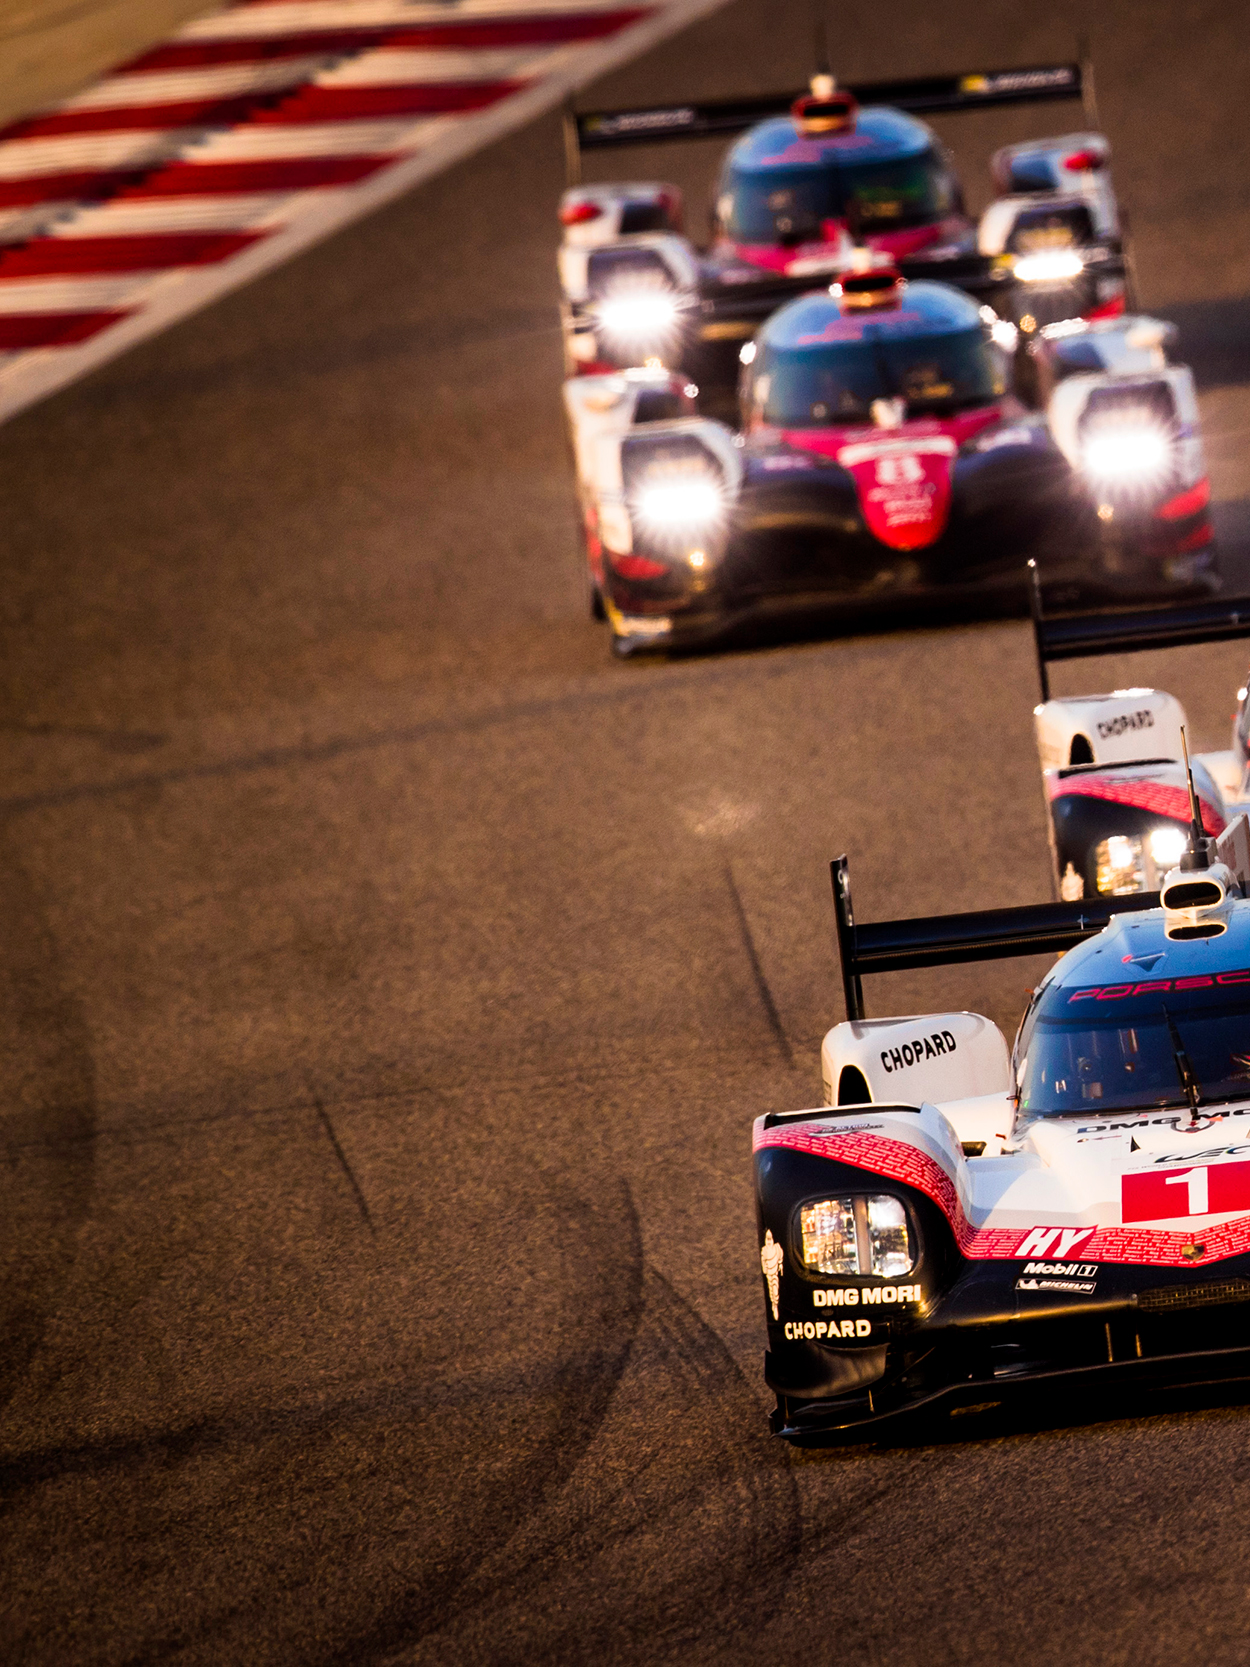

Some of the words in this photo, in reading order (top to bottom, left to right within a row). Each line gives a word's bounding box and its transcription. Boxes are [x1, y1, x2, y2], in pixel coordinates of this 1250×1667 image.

[1096, 709, 1155, 740] CHOPARD
[880, 1030, 957, 1073] CHOPARD
[1077, 1116, 1182, 1134] DMG
[1165, 1166, 1209, 1215] 1
[1014, 1227, 1095, 1258] HY
[1023, 1262, 1079, 1276] Mobil
[813, 1288, 859, 1307] DMG
[861, 1284, 921, 1304] MORI
[1038, 1280, 1094, 1291] MICHELIN
[784, 1319, 871, 1340] CHOPARD
